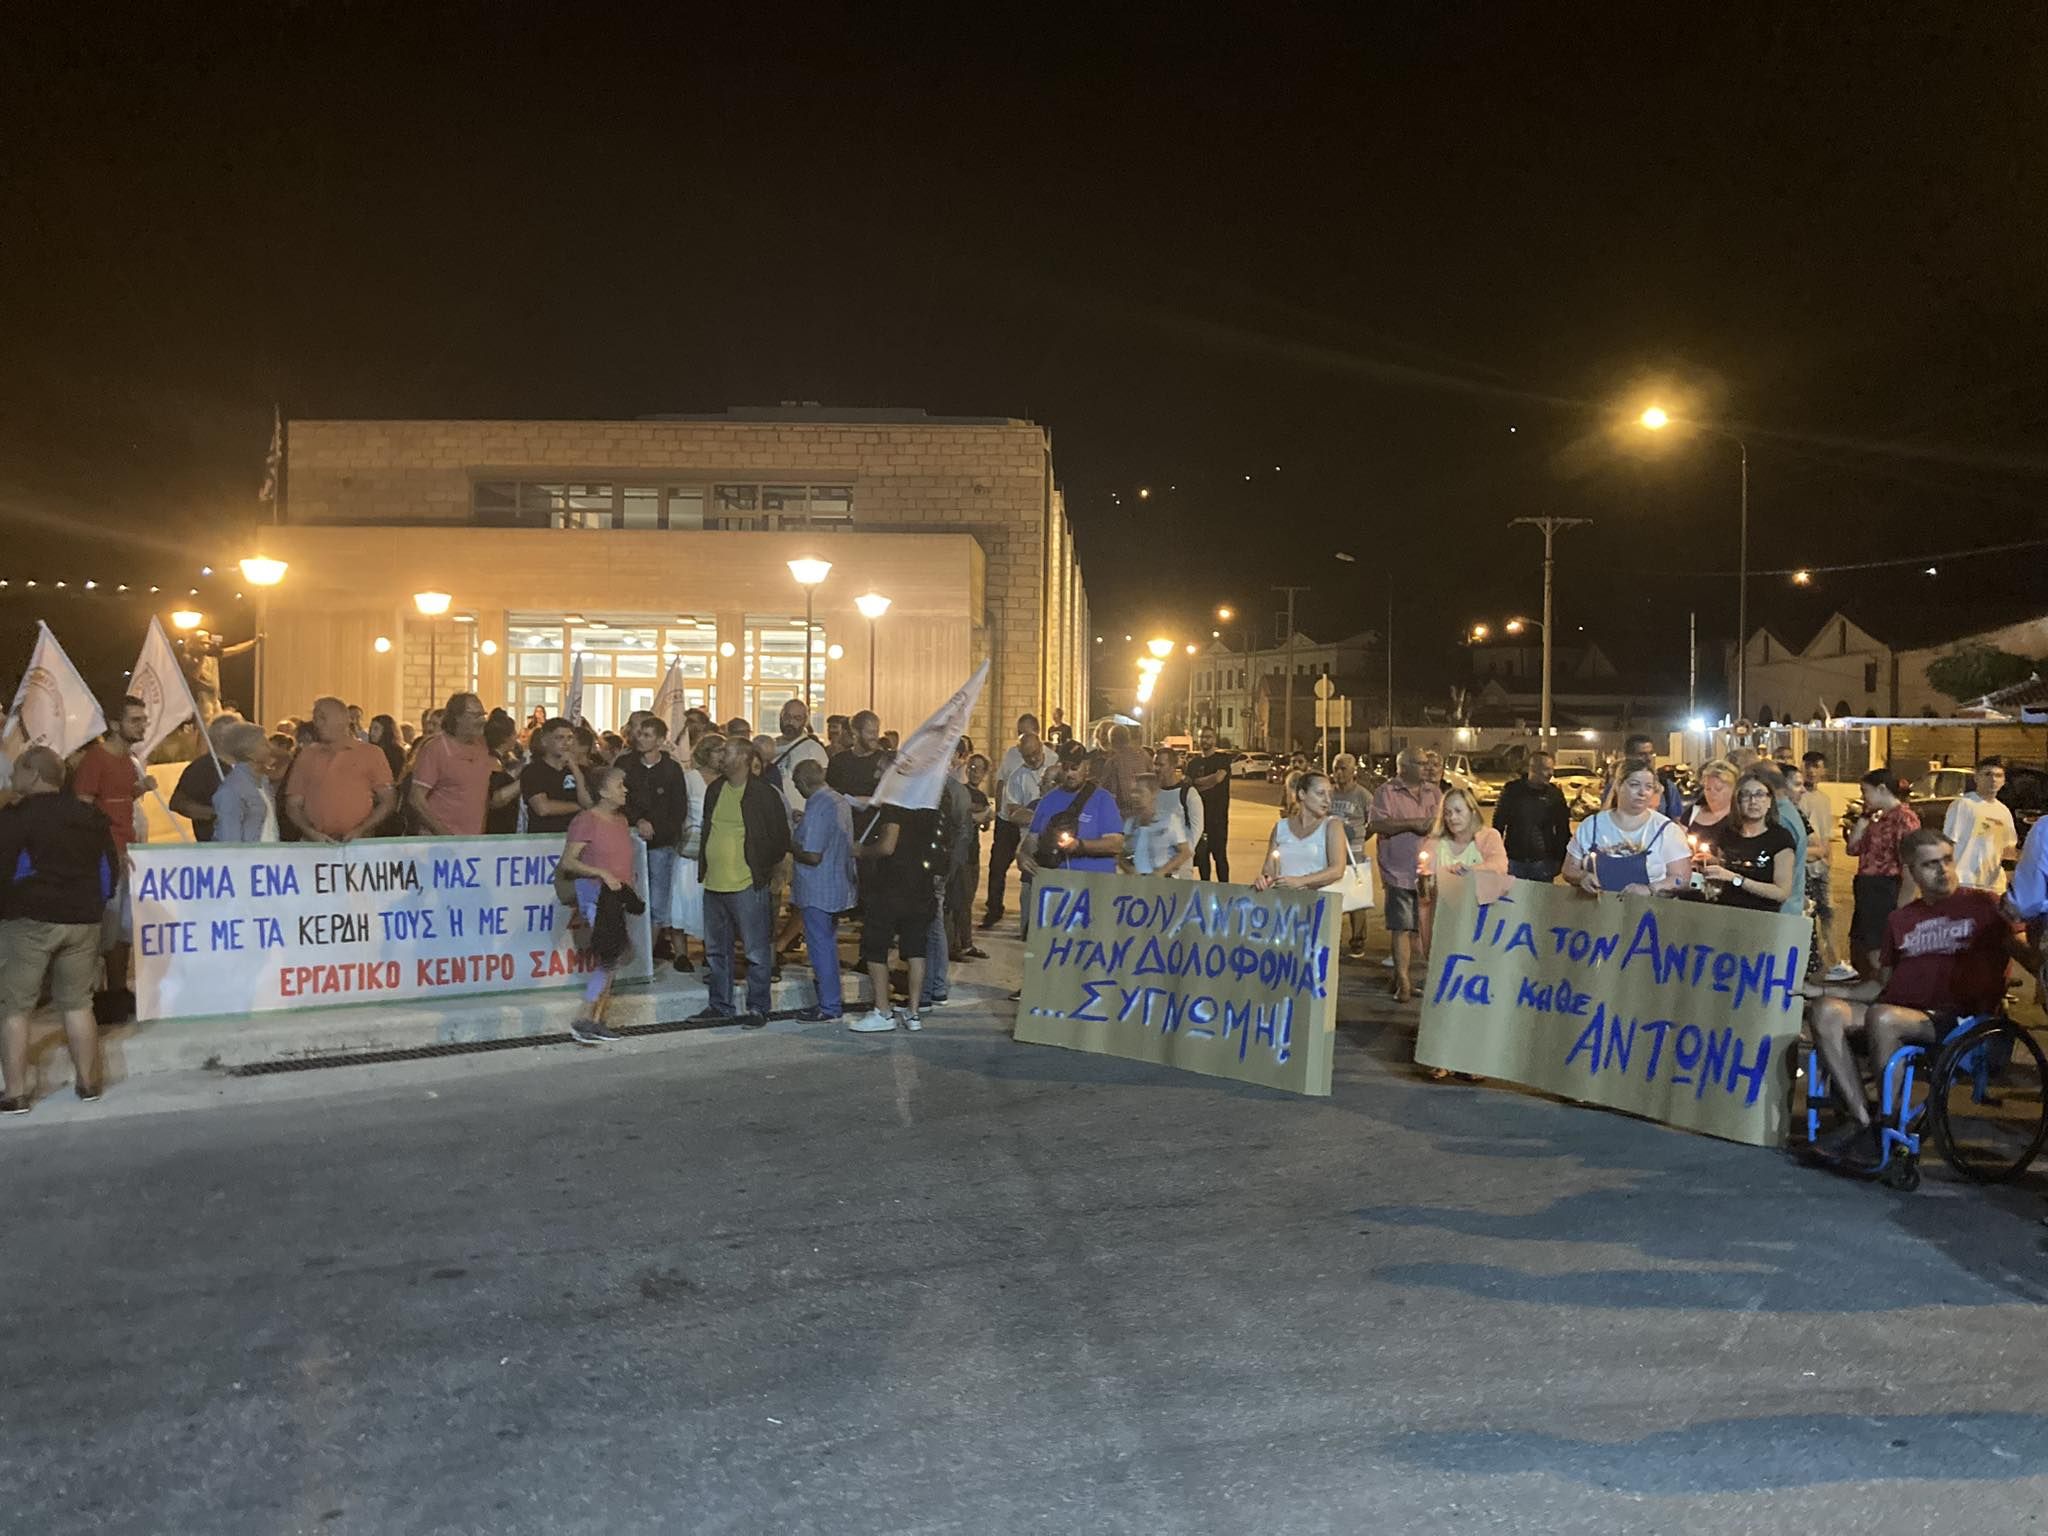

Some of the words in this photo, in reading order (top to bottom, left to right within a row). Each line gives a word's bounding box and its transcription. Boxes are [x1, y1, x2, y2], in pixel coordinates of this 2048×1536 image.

[139, 865, 235, 902] ΑΚΟΜΑ
[251, 864, 300, 897] ΕΝΑ
[315, 859, 424, 895] ΕΓΚΛΗΜΑ,
[433, 857, 481, 889] ΜΑΣ
[495, 855, 561, 887] ΓΕΜΙΣ
[141, 922, 197, 956] ΕΙΤΕ
[211, 919, 243, 951] ΜΕ
[253, 917, 284, 949] ΤΑ
[299, 912, 370, 946] ΚΕΡΔΗ
[379, 907, 437, 940] ΤΟΥΣ
[479, 906, 508, 935] ΜΕ
[524, 904, 554, 933] ΤΗ
[1037, 886, 1091, 932] ΓΙΑ
[280, 961, 400, 997] ΕΡΓΑΤΙΚΟ
[417, 953, 515, 988] ΚΕΝΤΡΟ
[529, 948, 599, 979] ΣΑΜΟ
[1043, 936, 1135, 975] ΗΤΑΝ
[1132, 936, 1330, 1000] ΔΟΛΟΦΟΝΙΑ!
[1620, 909, 1799, 1013] ΑΝΤΩΝΗ
[1564, 1002, 1773, 1108] ΑΝΤΩΝΗ
